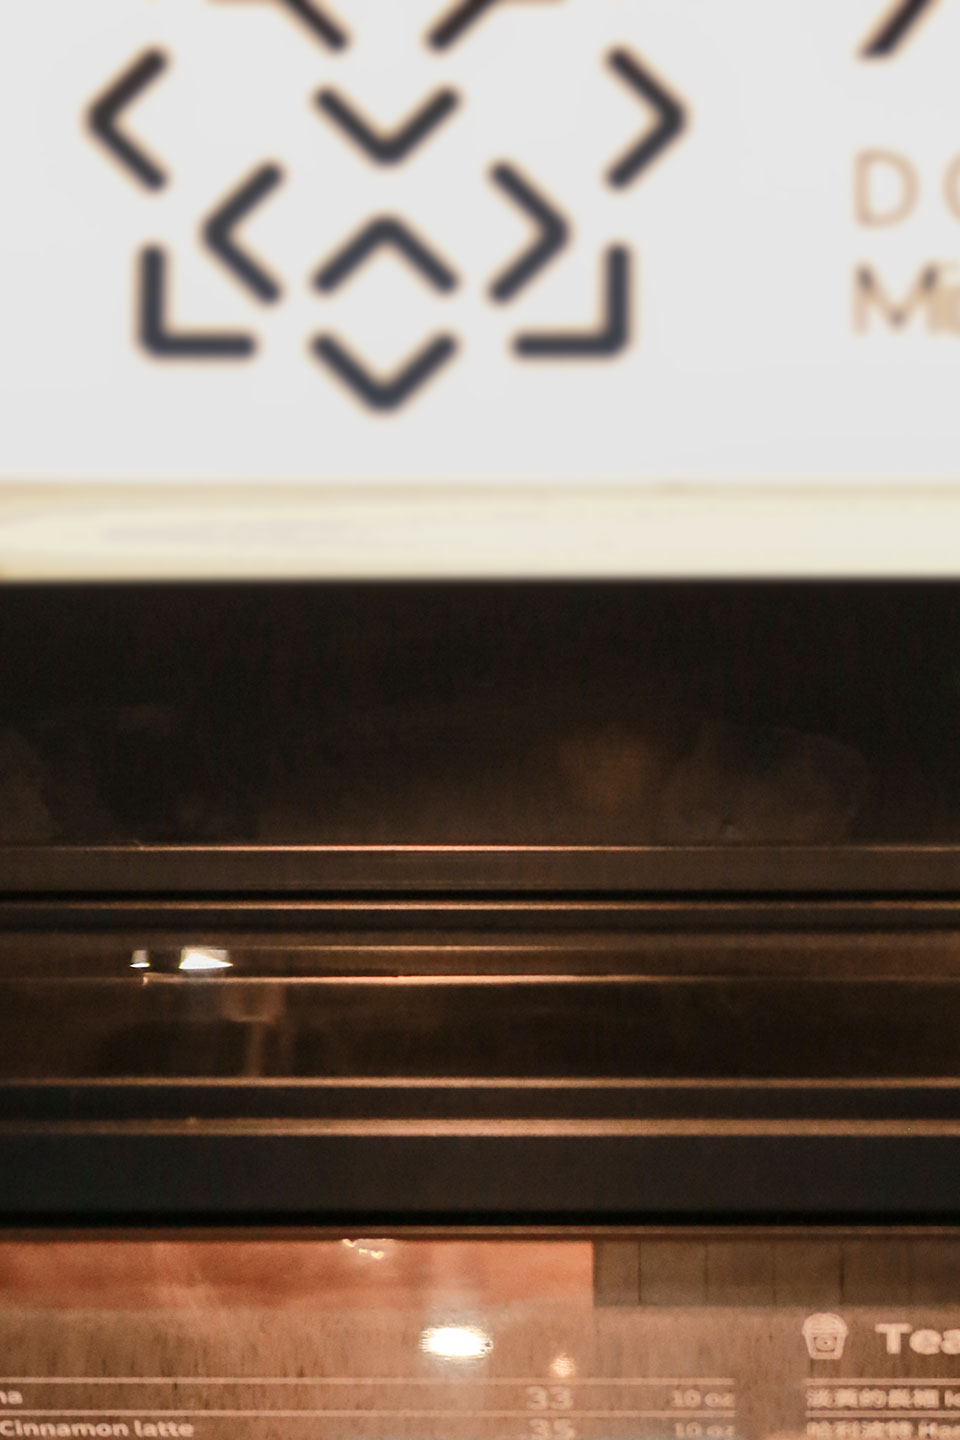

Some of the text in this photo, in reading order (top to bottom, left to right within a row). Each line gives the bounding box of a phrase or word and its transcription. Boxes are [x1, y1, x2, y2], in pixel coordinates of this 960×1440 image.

[854, 149, 917, 228] D
[526, 1386, 573, 1410] 33
[671, 1389, 735, 1408] 10 oz
[0, 1419, 195, 1438] Cinnamon latte
[674, 1422, 735, 1439] 10 oz
